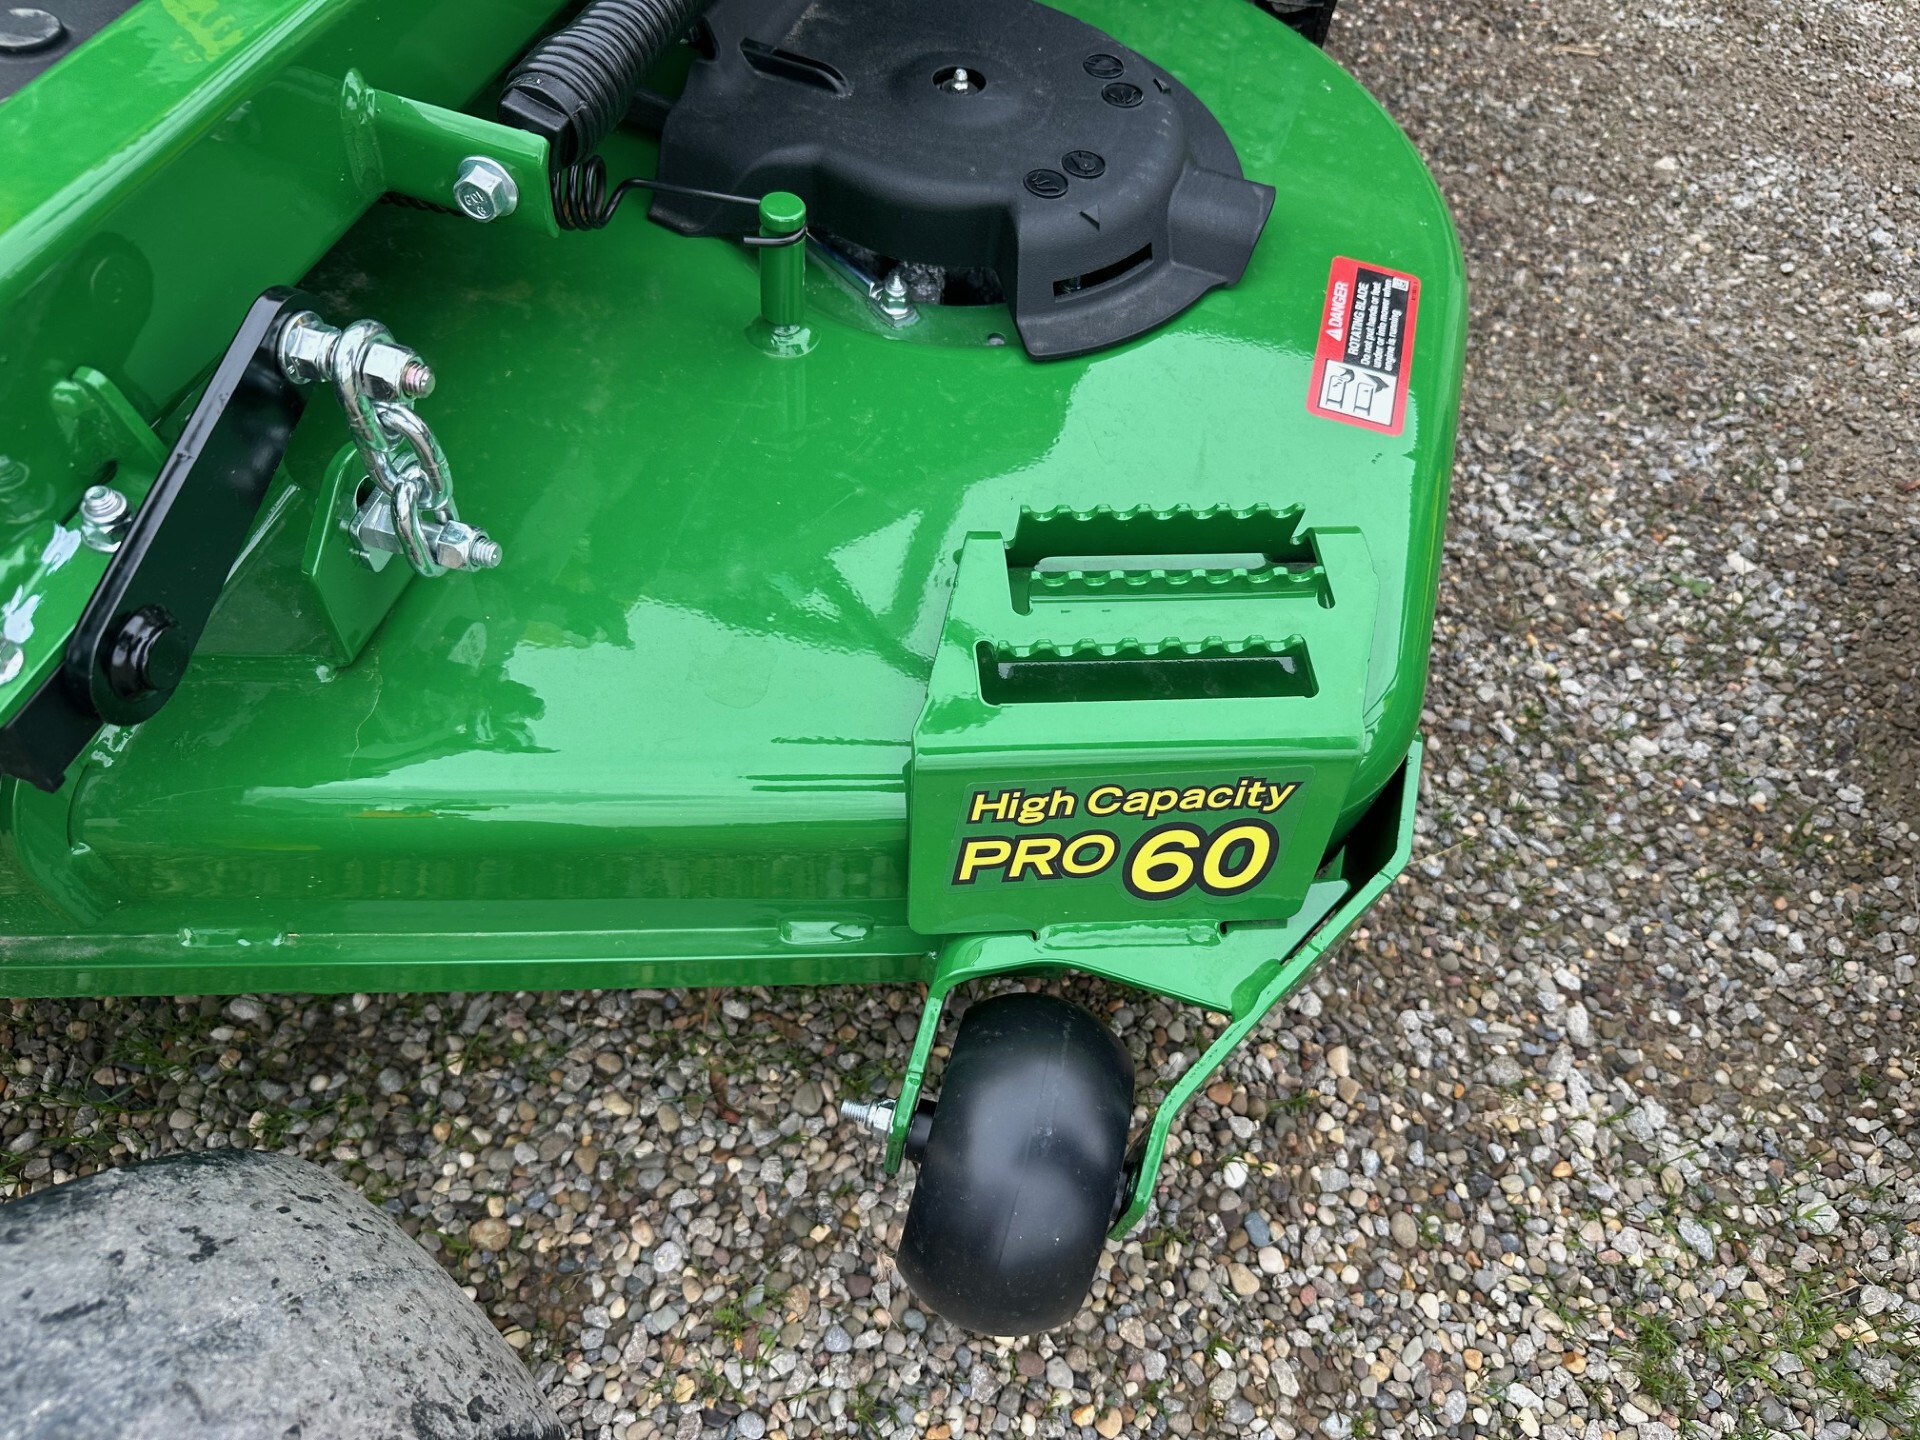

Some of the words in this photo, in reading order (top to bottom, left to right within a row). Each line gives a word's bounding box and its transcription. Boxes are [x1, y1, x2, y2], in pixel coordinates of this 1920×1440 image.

[1355, 281, 1370, 311] BLADE
[1370, 281, 1382, 296] feet
[1382, 278, 1392, 298] when
[1328, 281, 1349, 328] DANGER
[1371, 296, 1380, 305] or
[1380, 298, 1390, 322] mower
[1366, 305, 1379, 327] hands
[1389, 309, 1402, 338] running
[1347, 310, 1365, 356] ROTATING
[1366, 327, 1376, 341] put
[1376, 322, 1387, 337] into
[1364, 340, 1374, 354] not
[1377, 337, 1385, 346] or
[1386, 337, 1396, 346] is
[1360, 354, 1371, 366] Do
[1373, 345, 1384, 368] under
[1384, 345, 1396, 372] engine
[969, 788, 1076, 825] High
[1087, 779, 1297, 819] Capacity
[956, 833, 1117, 882] PRO
[1128, 824, 1272, 895] 60
